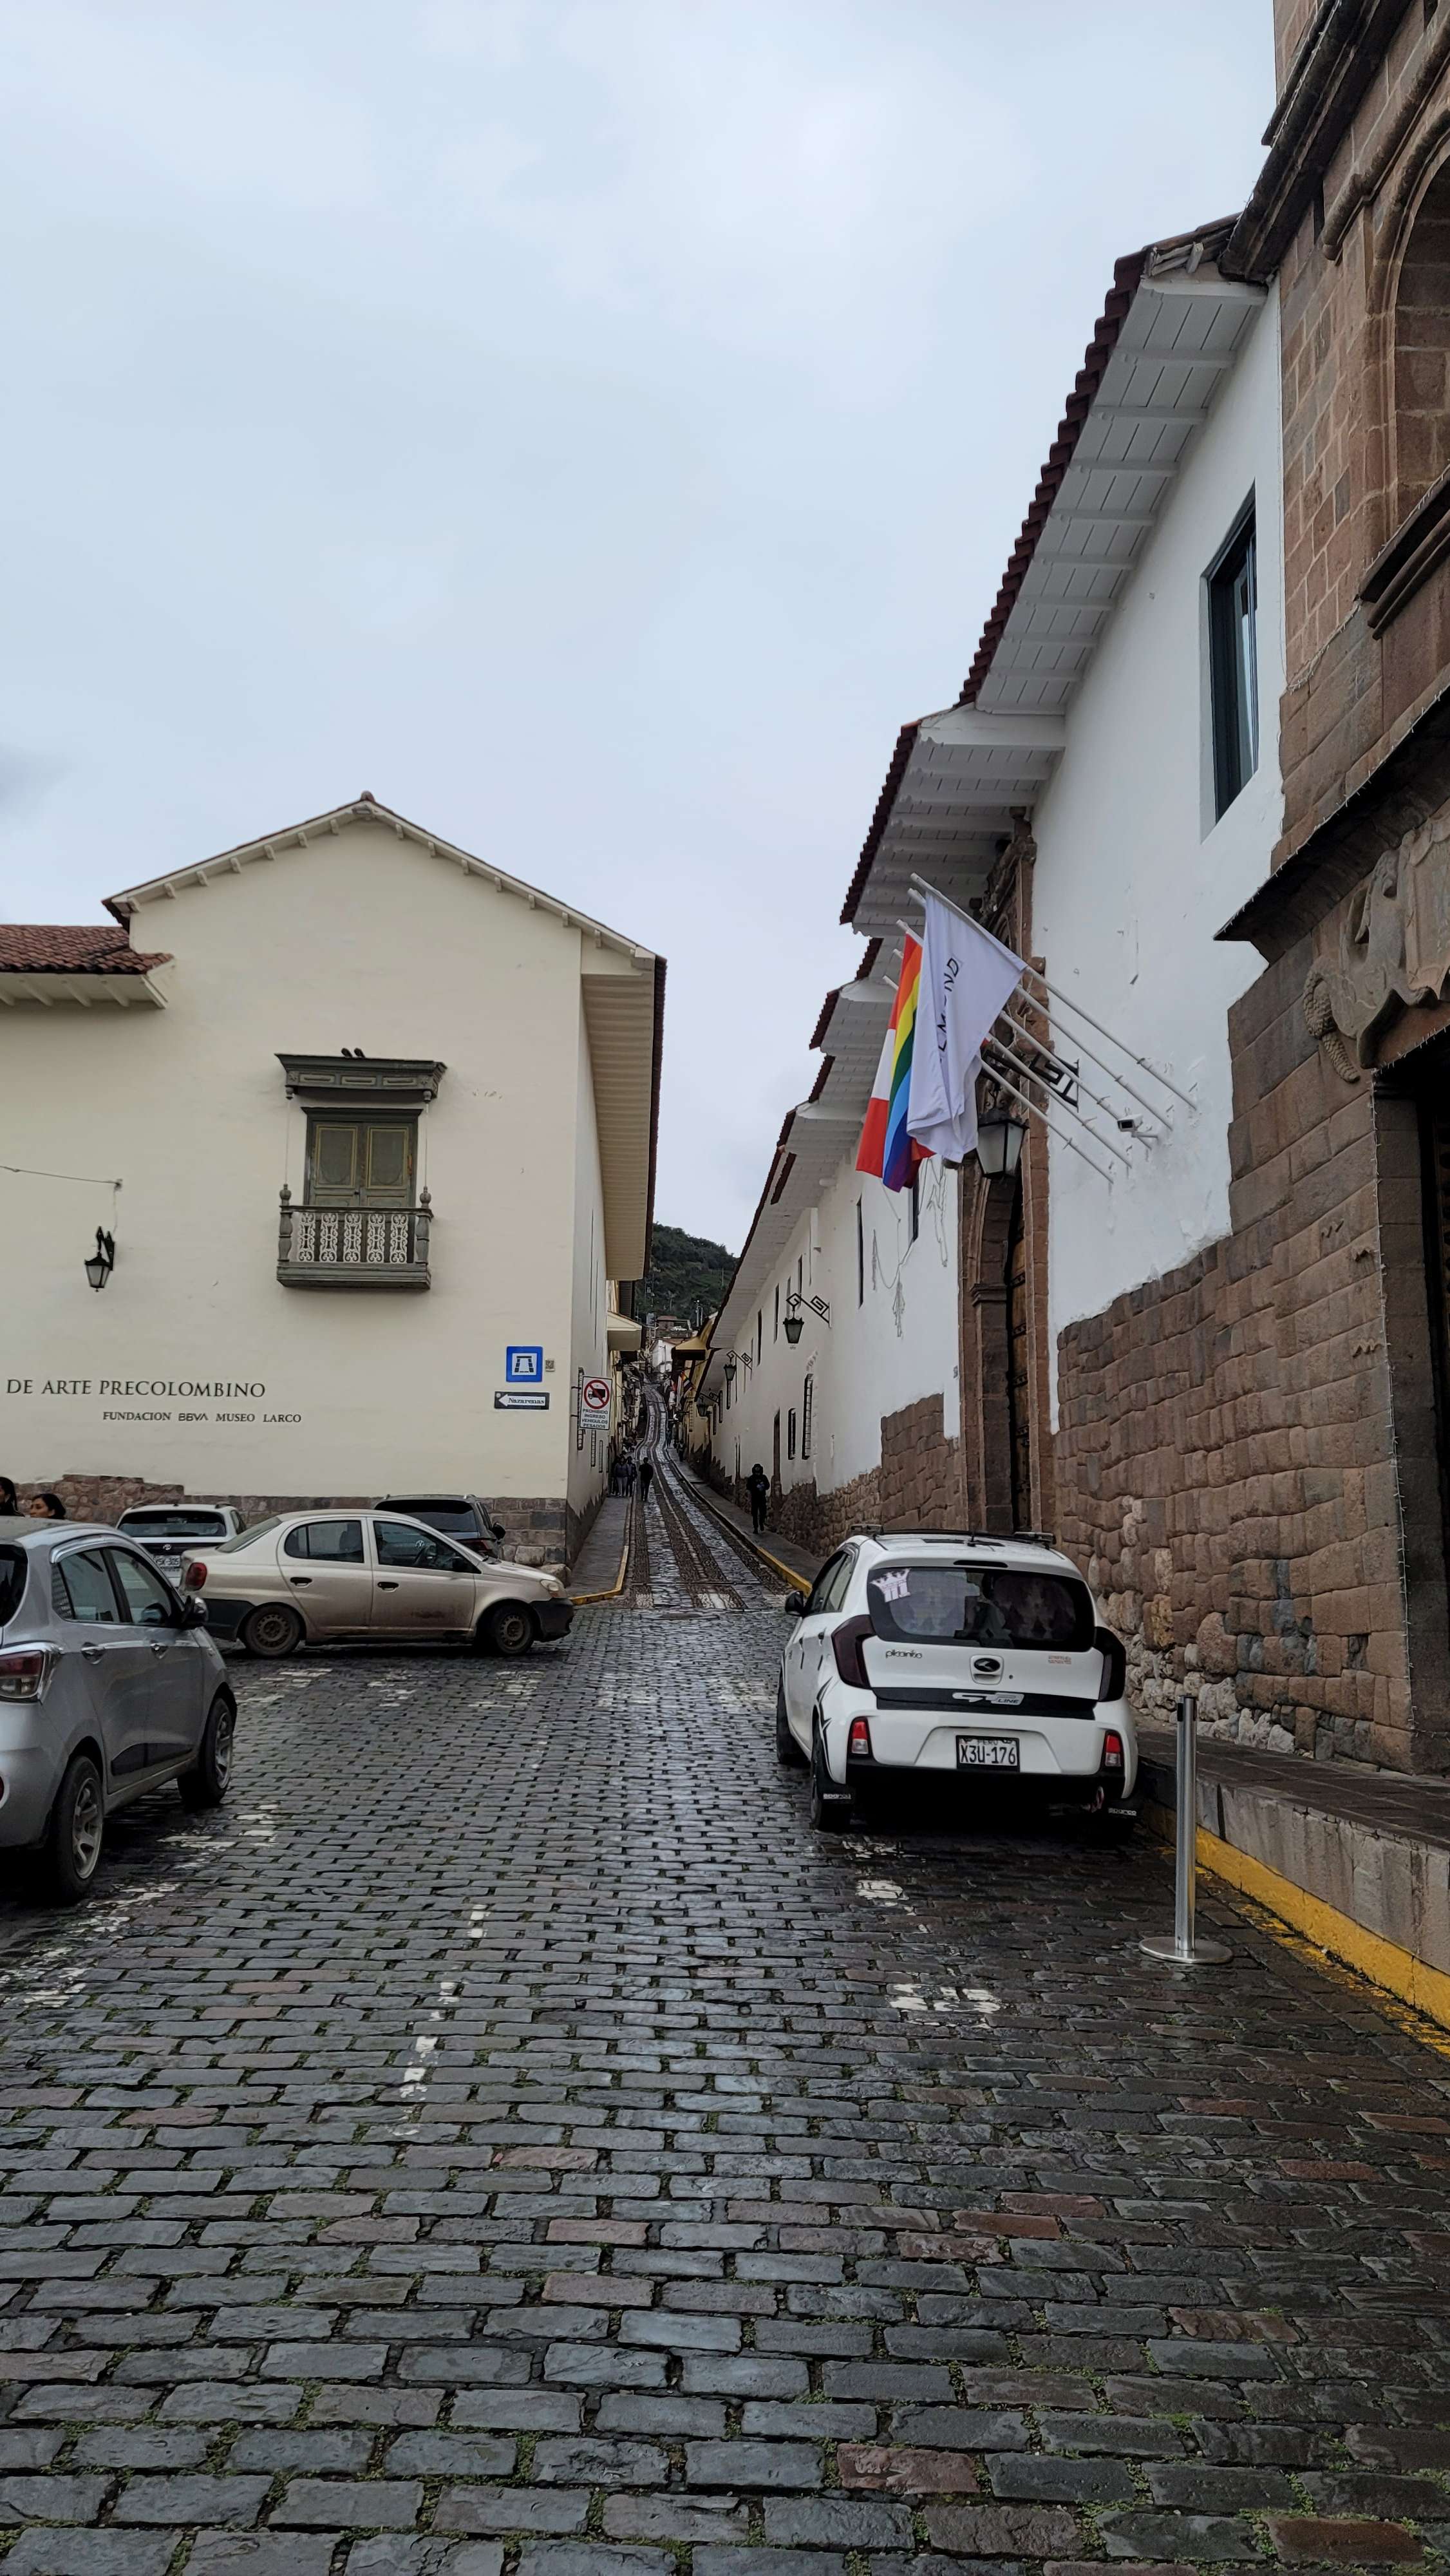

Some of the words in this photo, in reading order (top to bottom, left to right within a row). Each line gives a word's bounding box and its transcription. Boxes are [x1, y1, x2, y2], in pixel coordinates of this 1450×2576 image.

[6, 1379, 33, 1394] DE
[41, 1379, 92, 1395] ARTE
[99, 1380, 266, 1398] PRECOLOMBINO
[102, 1411, 173, 1421] FUNDACION
[178, 1412, 209, 1421] BBVA
[215, 1413, 256, 1423] MUSEO
[263, 1414, 302, 1423] LARCO
[960, 1744, 1016, 1765] X3U-176
